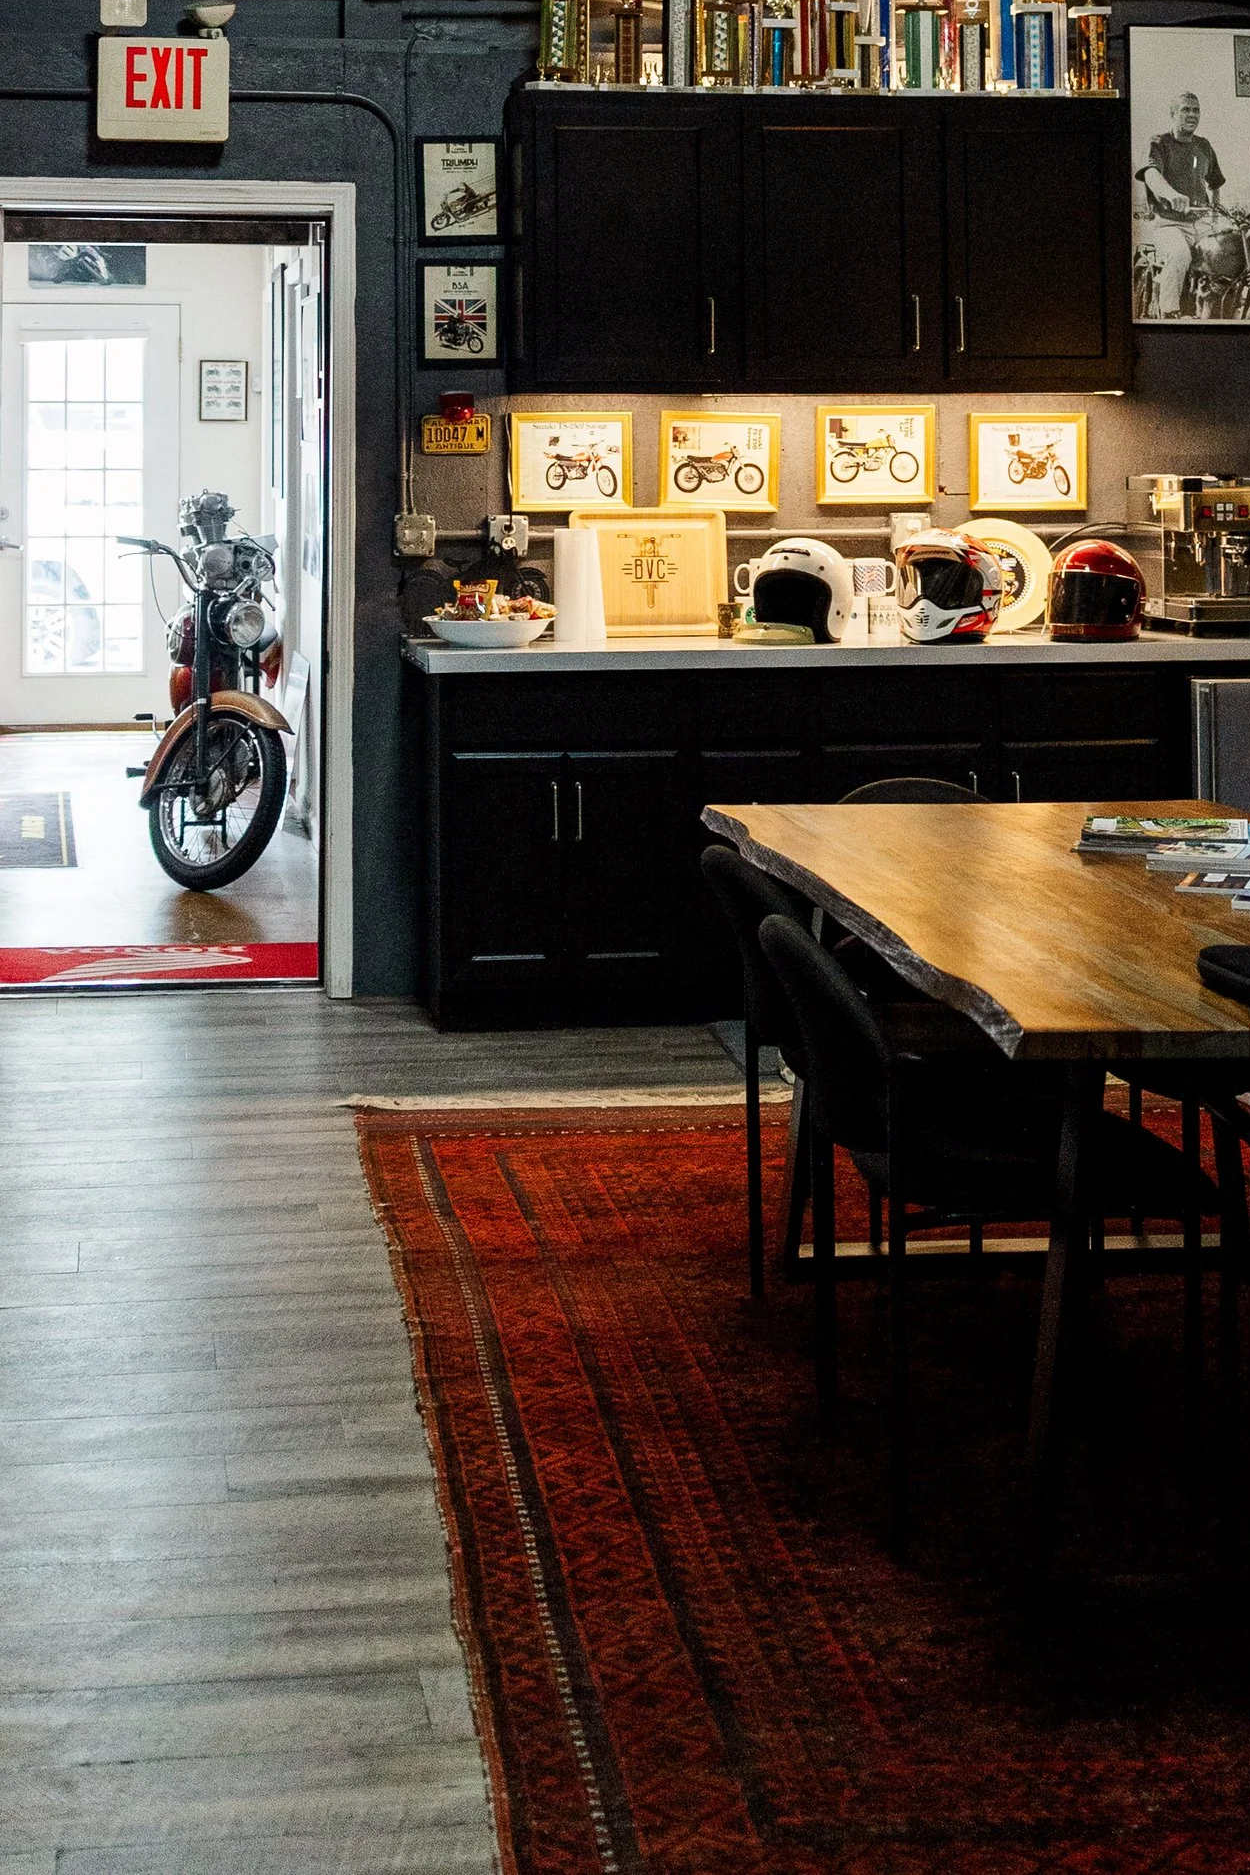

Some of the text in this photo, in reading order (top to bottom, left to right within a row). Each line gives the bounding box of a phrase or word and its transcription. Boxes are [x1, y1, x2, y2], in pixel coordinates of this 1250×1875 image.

[125, 46, 208, 110] EXIT
[441, 158, 478, 167] TRIUMPH
[427, 427, 467, 443] 10047
[634, 558, 666, 580] BVC
